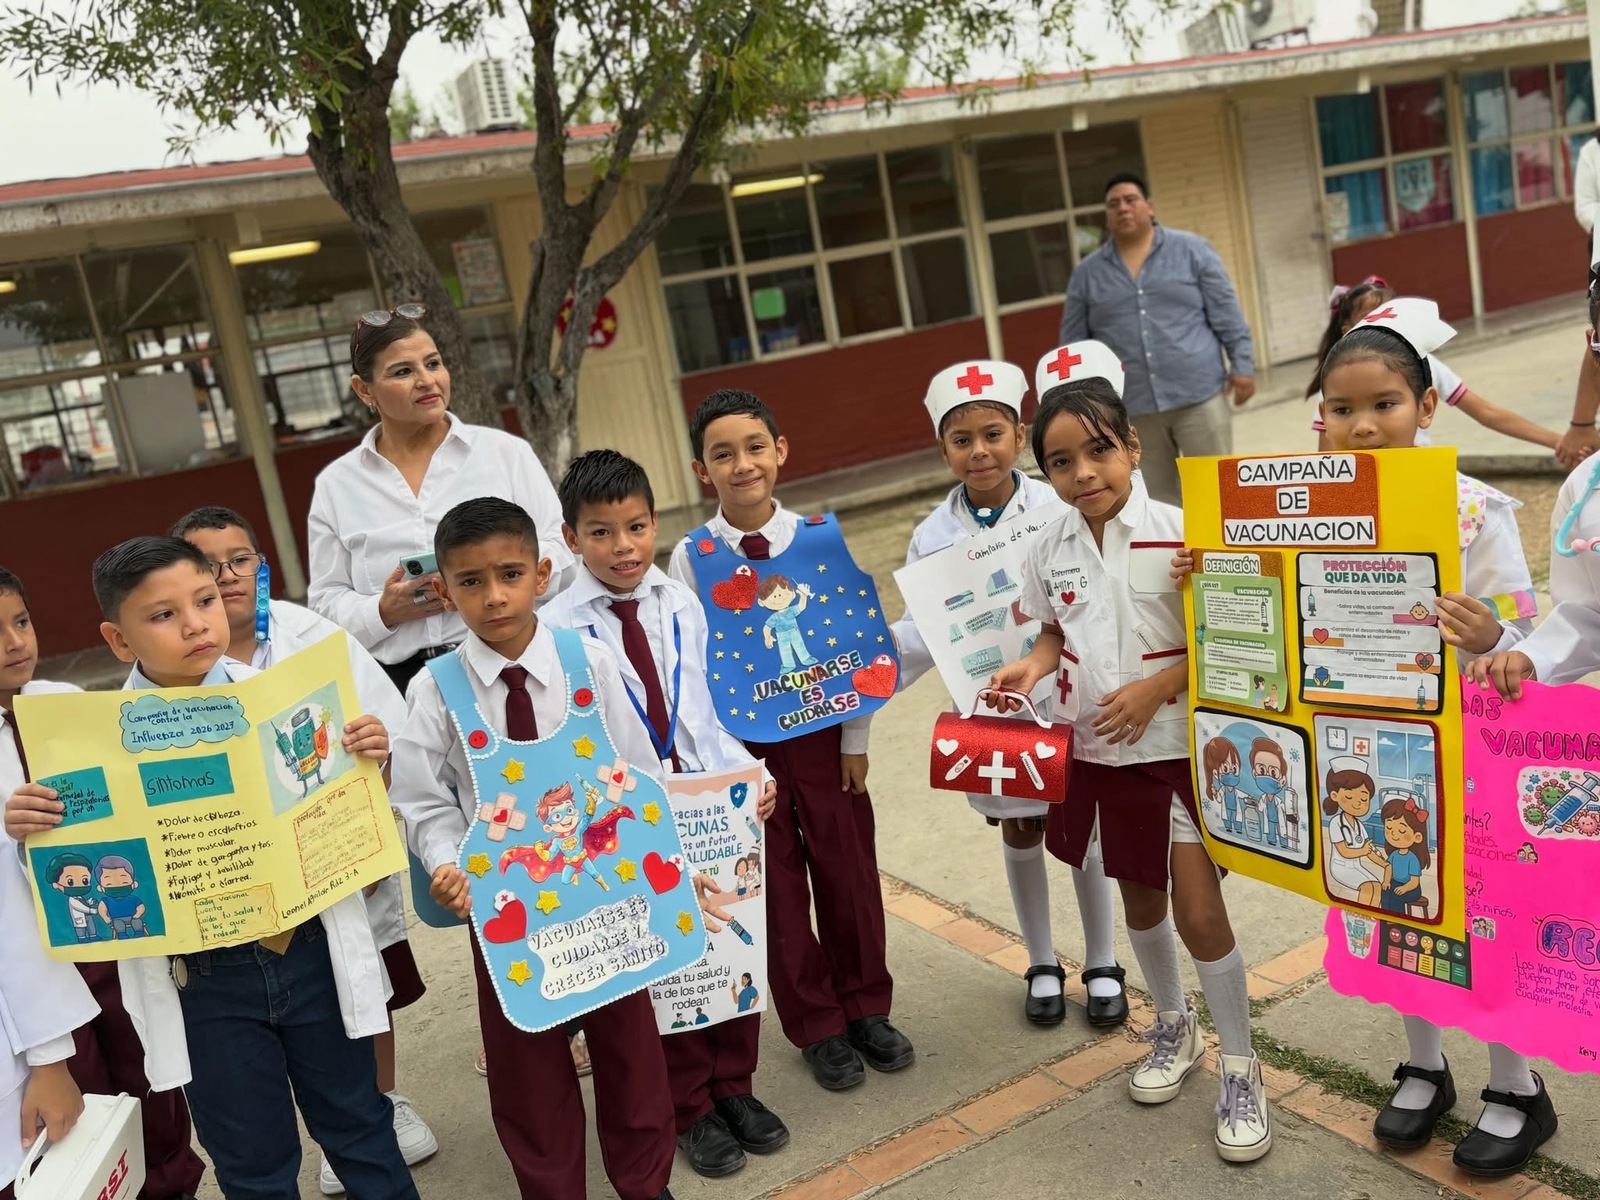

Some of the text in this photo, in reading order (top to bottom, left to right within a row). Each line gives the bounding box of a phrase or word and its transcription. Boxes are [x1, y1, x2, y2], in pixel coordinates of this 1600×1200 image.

[1238, 455, 1353, 482] CAMPAÑA
[1278, 490, 1307, 510] DE
[1010, 526, 1022, 541] de
[1226, 521, 1373, 542] VACUNACION
[1205, 556, 1259, 574] DEFINICIÓN
[1323, 557, 1407, 572] PROTECCIÓN
[1080, 576, 1088, 588] G
[1325, 572, 1407, 584] QUE DA VIDA
[802, 686, 824, 704] ES
[779, 694, 858, 730] CUIDARSE
[131, 720, 234, 744] Influenza 2026 2027
[706, 808, 711, 816] a
[714, 804, 725, 815] las
[696, 840, 706, 848] un
[708, 834, 736, 847] futuro
[198, 858, 208, 866] de
[252, 843, 257, 852] y
[206, 870, 211, 880] y
[709, 865, 719, 876] TÚ
[257, 906, 263, 914] y
[230, 918, 246, 929] que
[530, 897, 648, 950] VACUNARSE ES
[551, 924, 642, 969] CUIDARSE Y
[1542, 921, 1600, 965] RE
[544, 941, 666, 997] CRECER SANITO
[684, 973, 695, 982] tu
[697, 965, 724, 981] salud
[724, 965, 731, 977] y
[652, 979, 728, 1000] la de los que te
